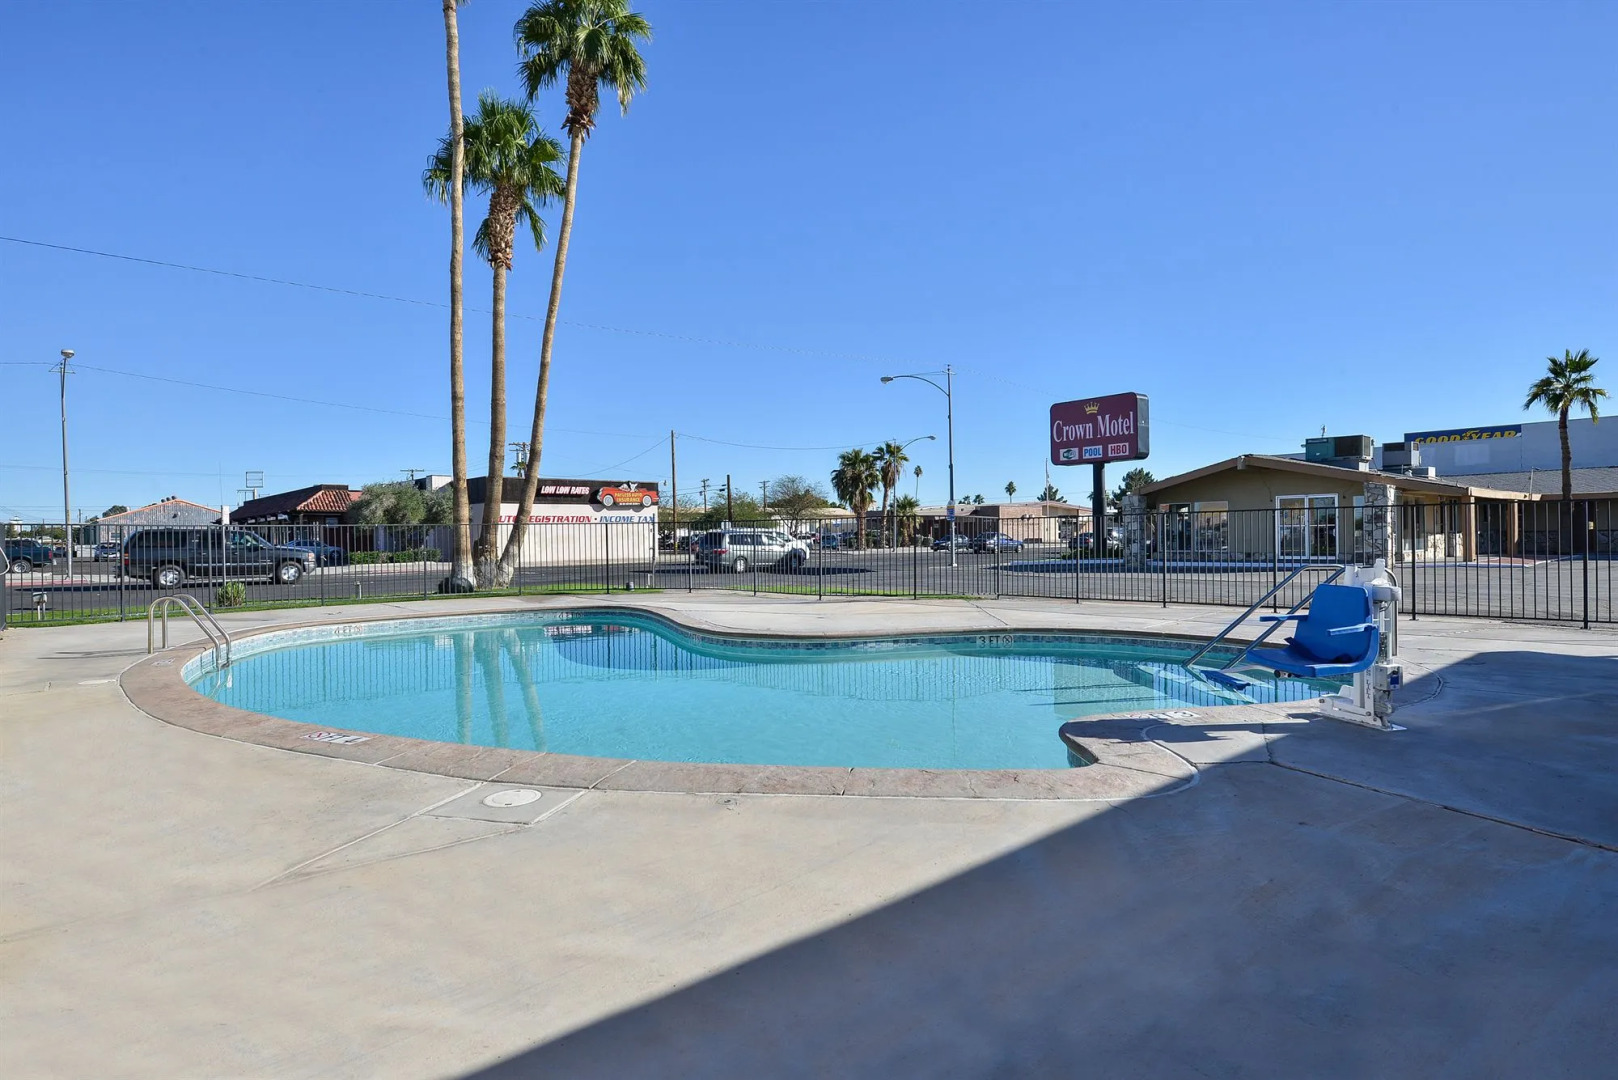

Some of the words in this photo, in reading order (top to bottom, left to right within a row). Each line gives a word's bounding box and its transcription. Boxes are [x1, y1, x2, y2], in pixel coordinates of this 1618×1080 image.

[1053, 420, 1093, 443] Crown
[1097, 411, 1134, 438] Motel
[1084, 447, 1102, 457] POOL
[1110, 444, 1127, 455] HBO
[541, 485, 556, 494] LOW
[556, 486, 571, 495] LOW
[571, 486, 590, 495] RATES
[529, 515, 592, 523] EGISTRATION
[600, 515, 635, 523] INCOME
[637, 515, 655, 523] TAX
[979, 635, 986, 644] 3
[989, 635, 1000, 644] FT
